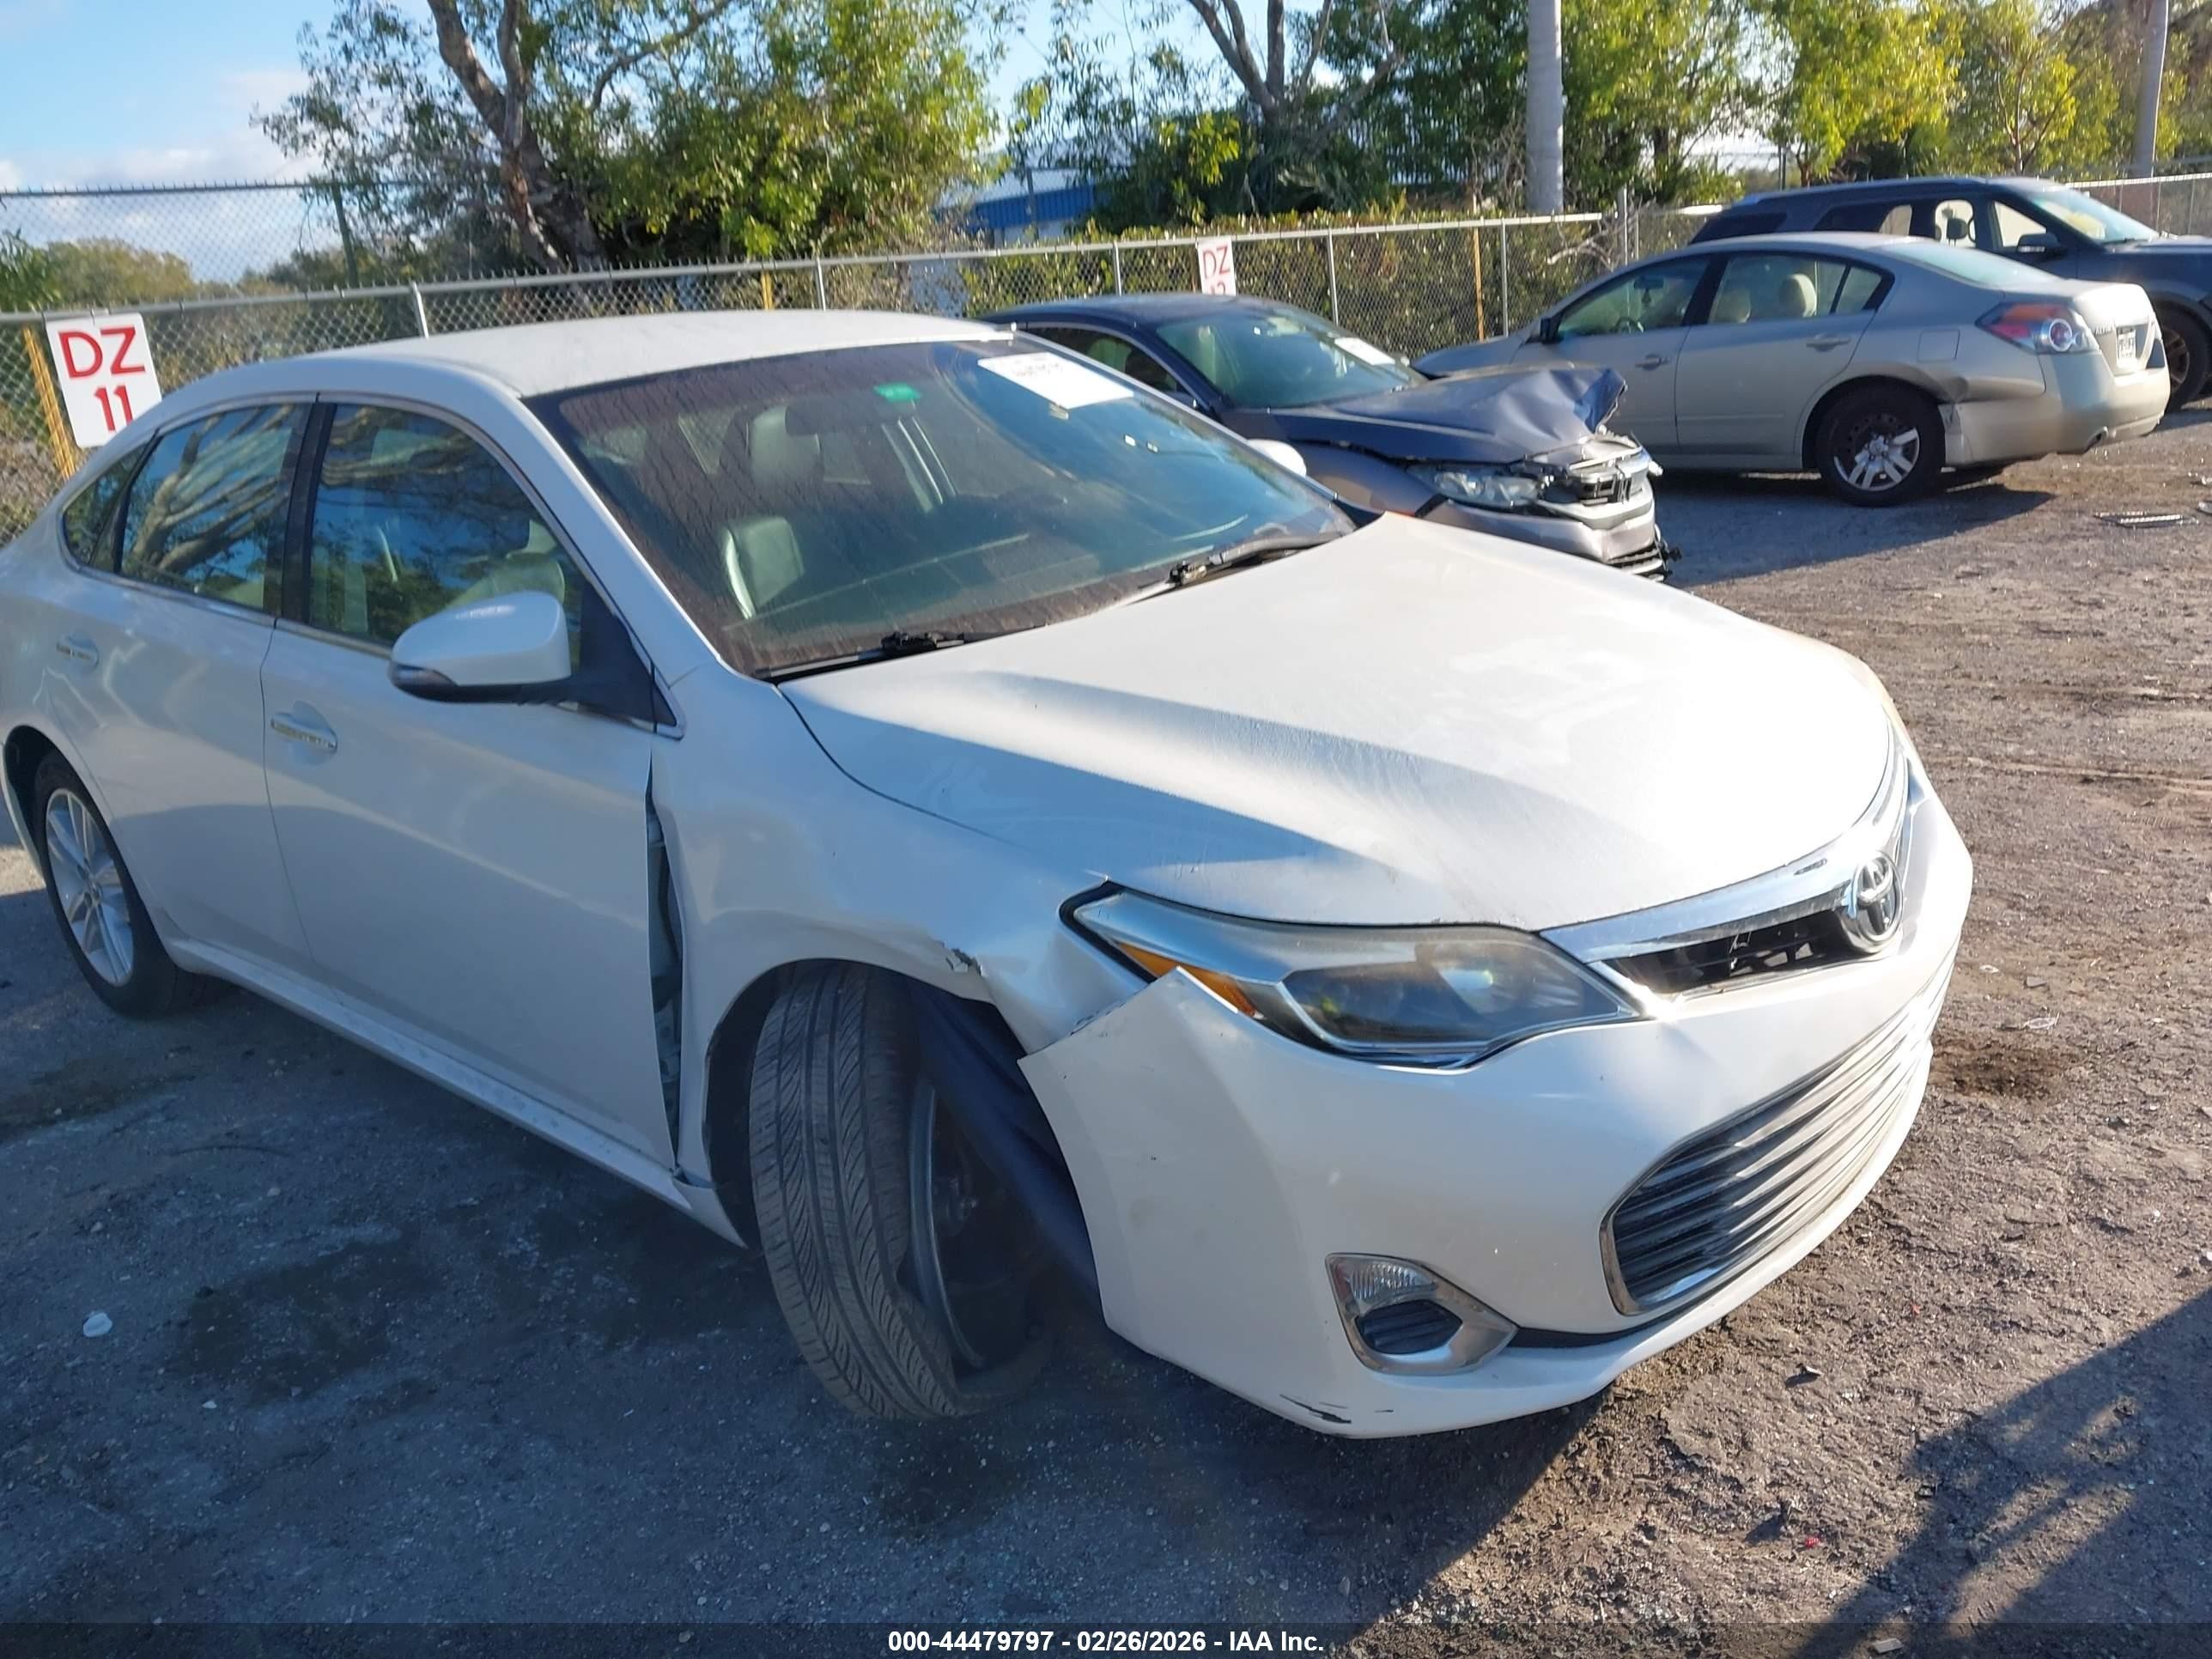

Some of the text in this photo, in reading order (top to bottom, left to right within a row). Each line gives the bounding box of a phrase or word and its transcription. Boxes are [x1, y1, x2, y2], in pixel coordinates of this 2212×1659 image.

[1203, 246, 1231, 279] DZ
[58, 326, 145, 378] DZ
[94, 385, 134, 431] 11
